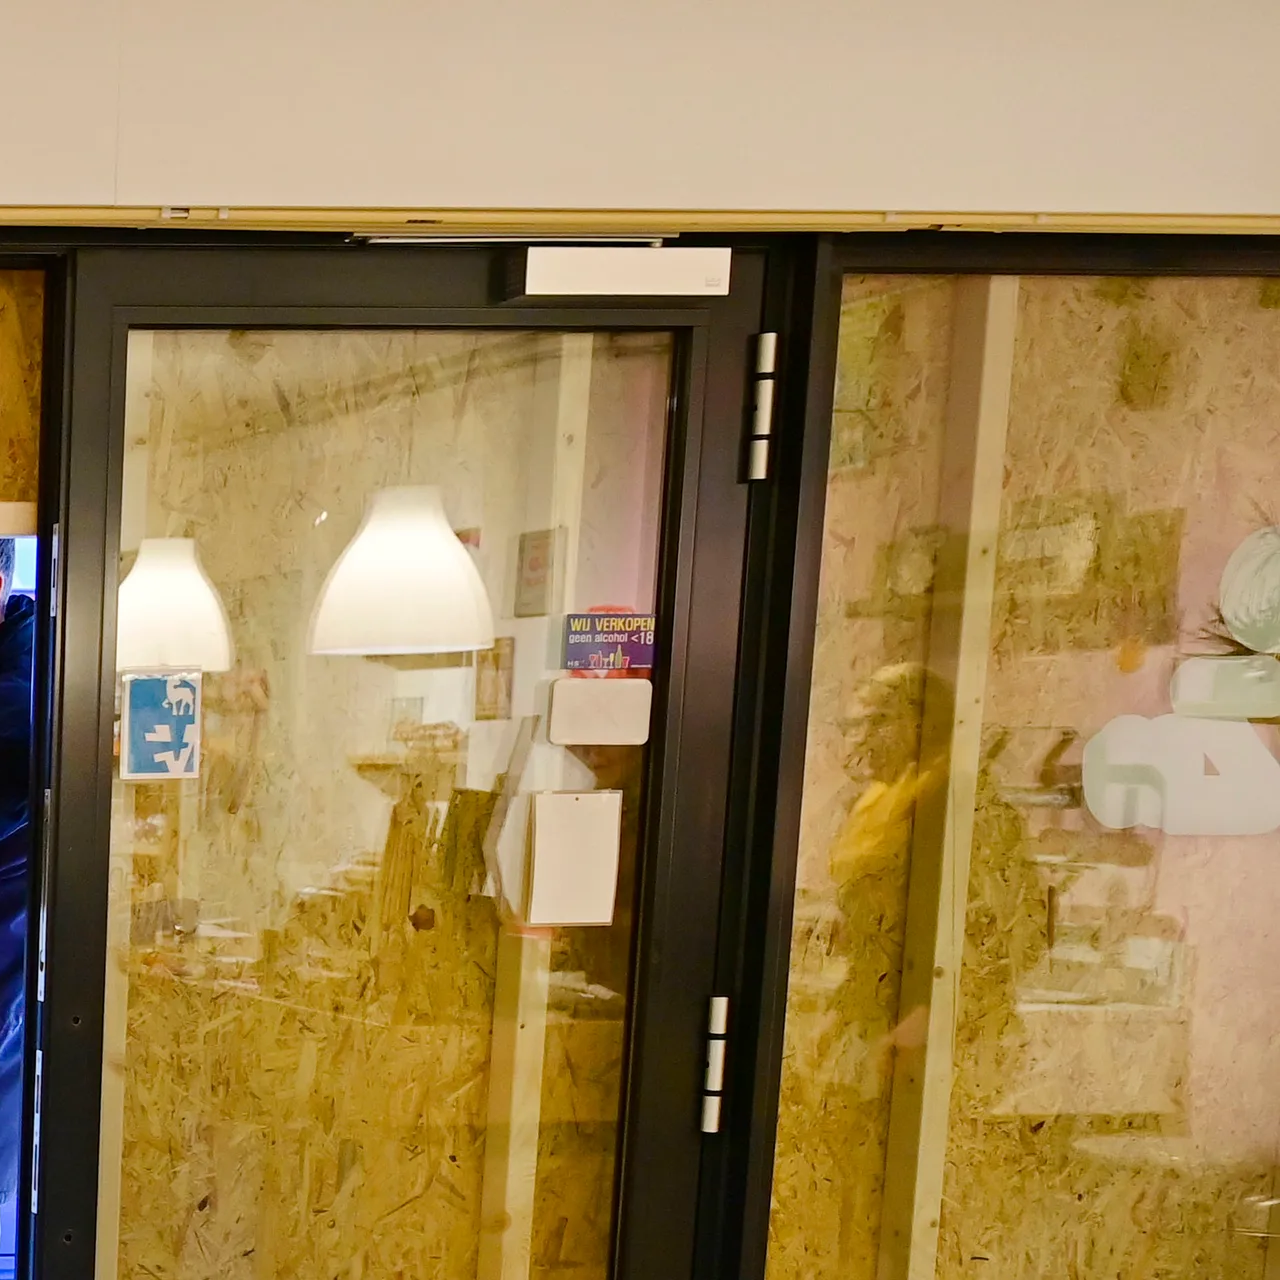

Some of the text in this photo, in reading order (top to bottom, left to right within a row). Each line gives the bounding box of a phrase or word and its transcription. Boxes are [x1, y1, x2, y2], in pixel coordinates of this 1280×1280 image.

[570, 617, 655, 631] WIJ VERKOPEN
[569, 631, 654, 644] geen alcohol <18
